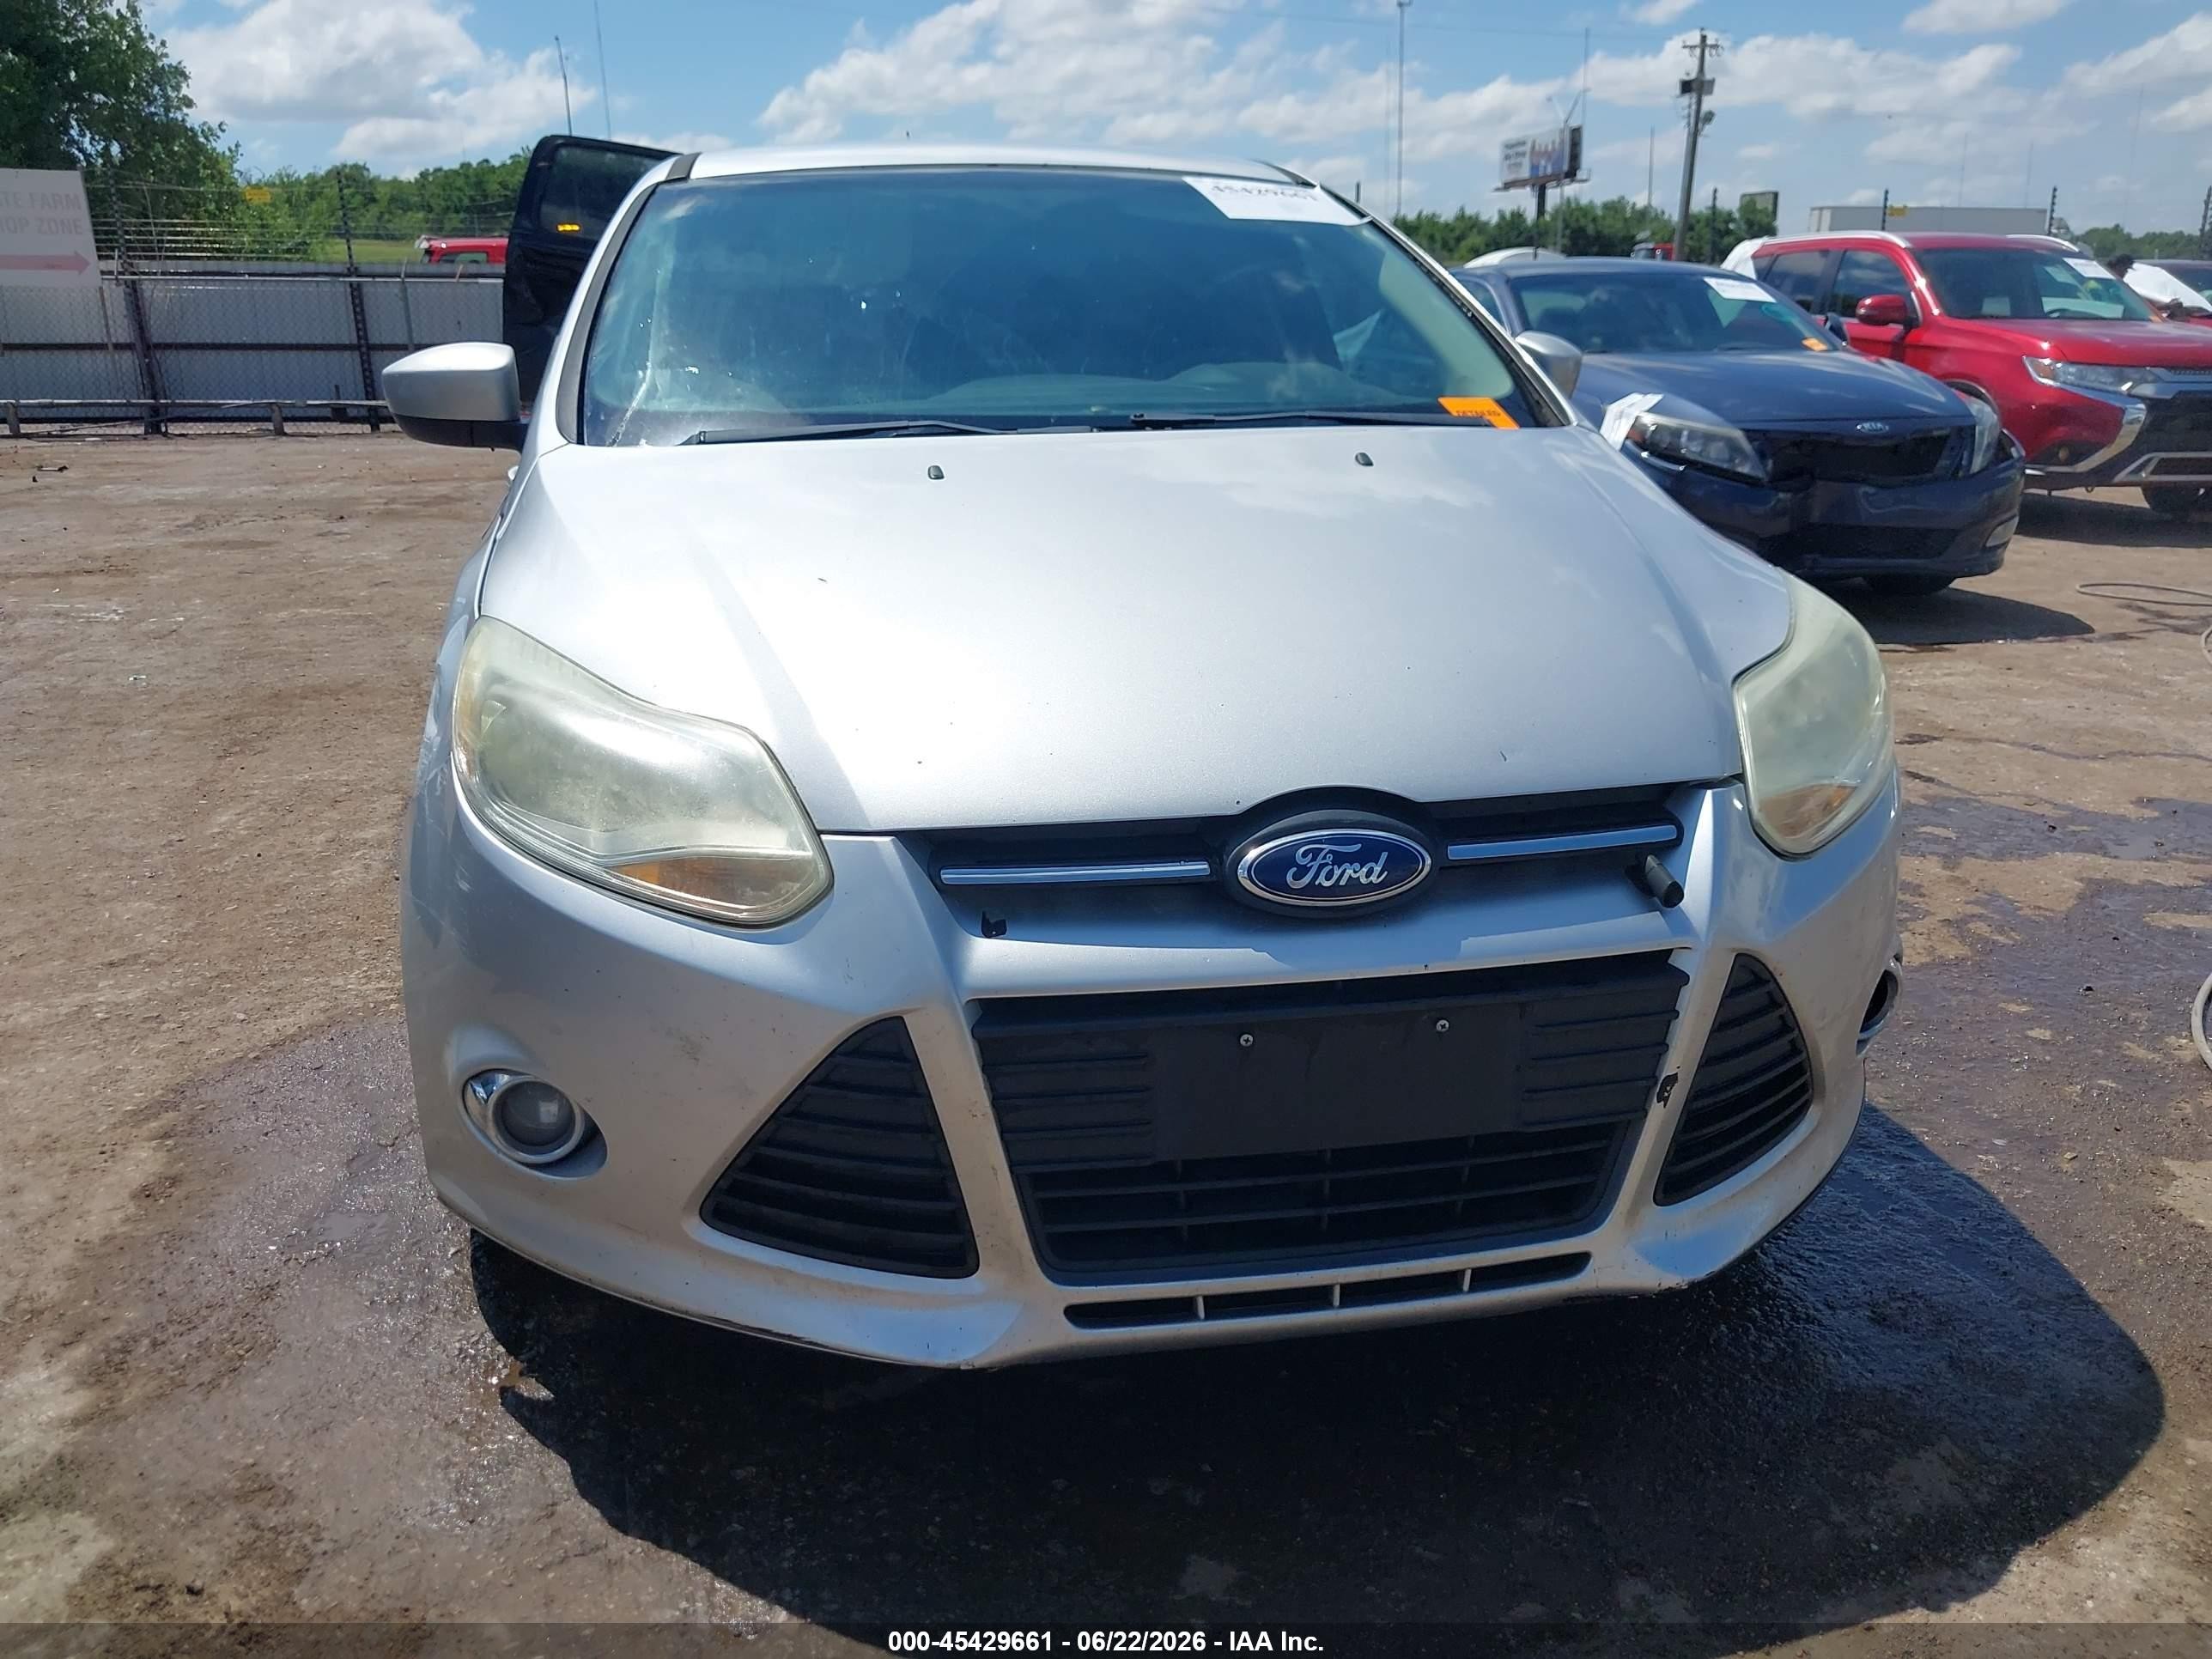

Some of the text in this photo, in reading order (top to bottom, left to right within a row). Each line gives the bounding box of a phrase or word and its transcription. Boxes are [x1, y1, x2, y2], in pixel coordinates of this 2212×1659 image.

[0, 191, 82, 210] TE FARM
[37, 217, 83, 235] ZONE
[1286, 843, 1389, 890] Ford
